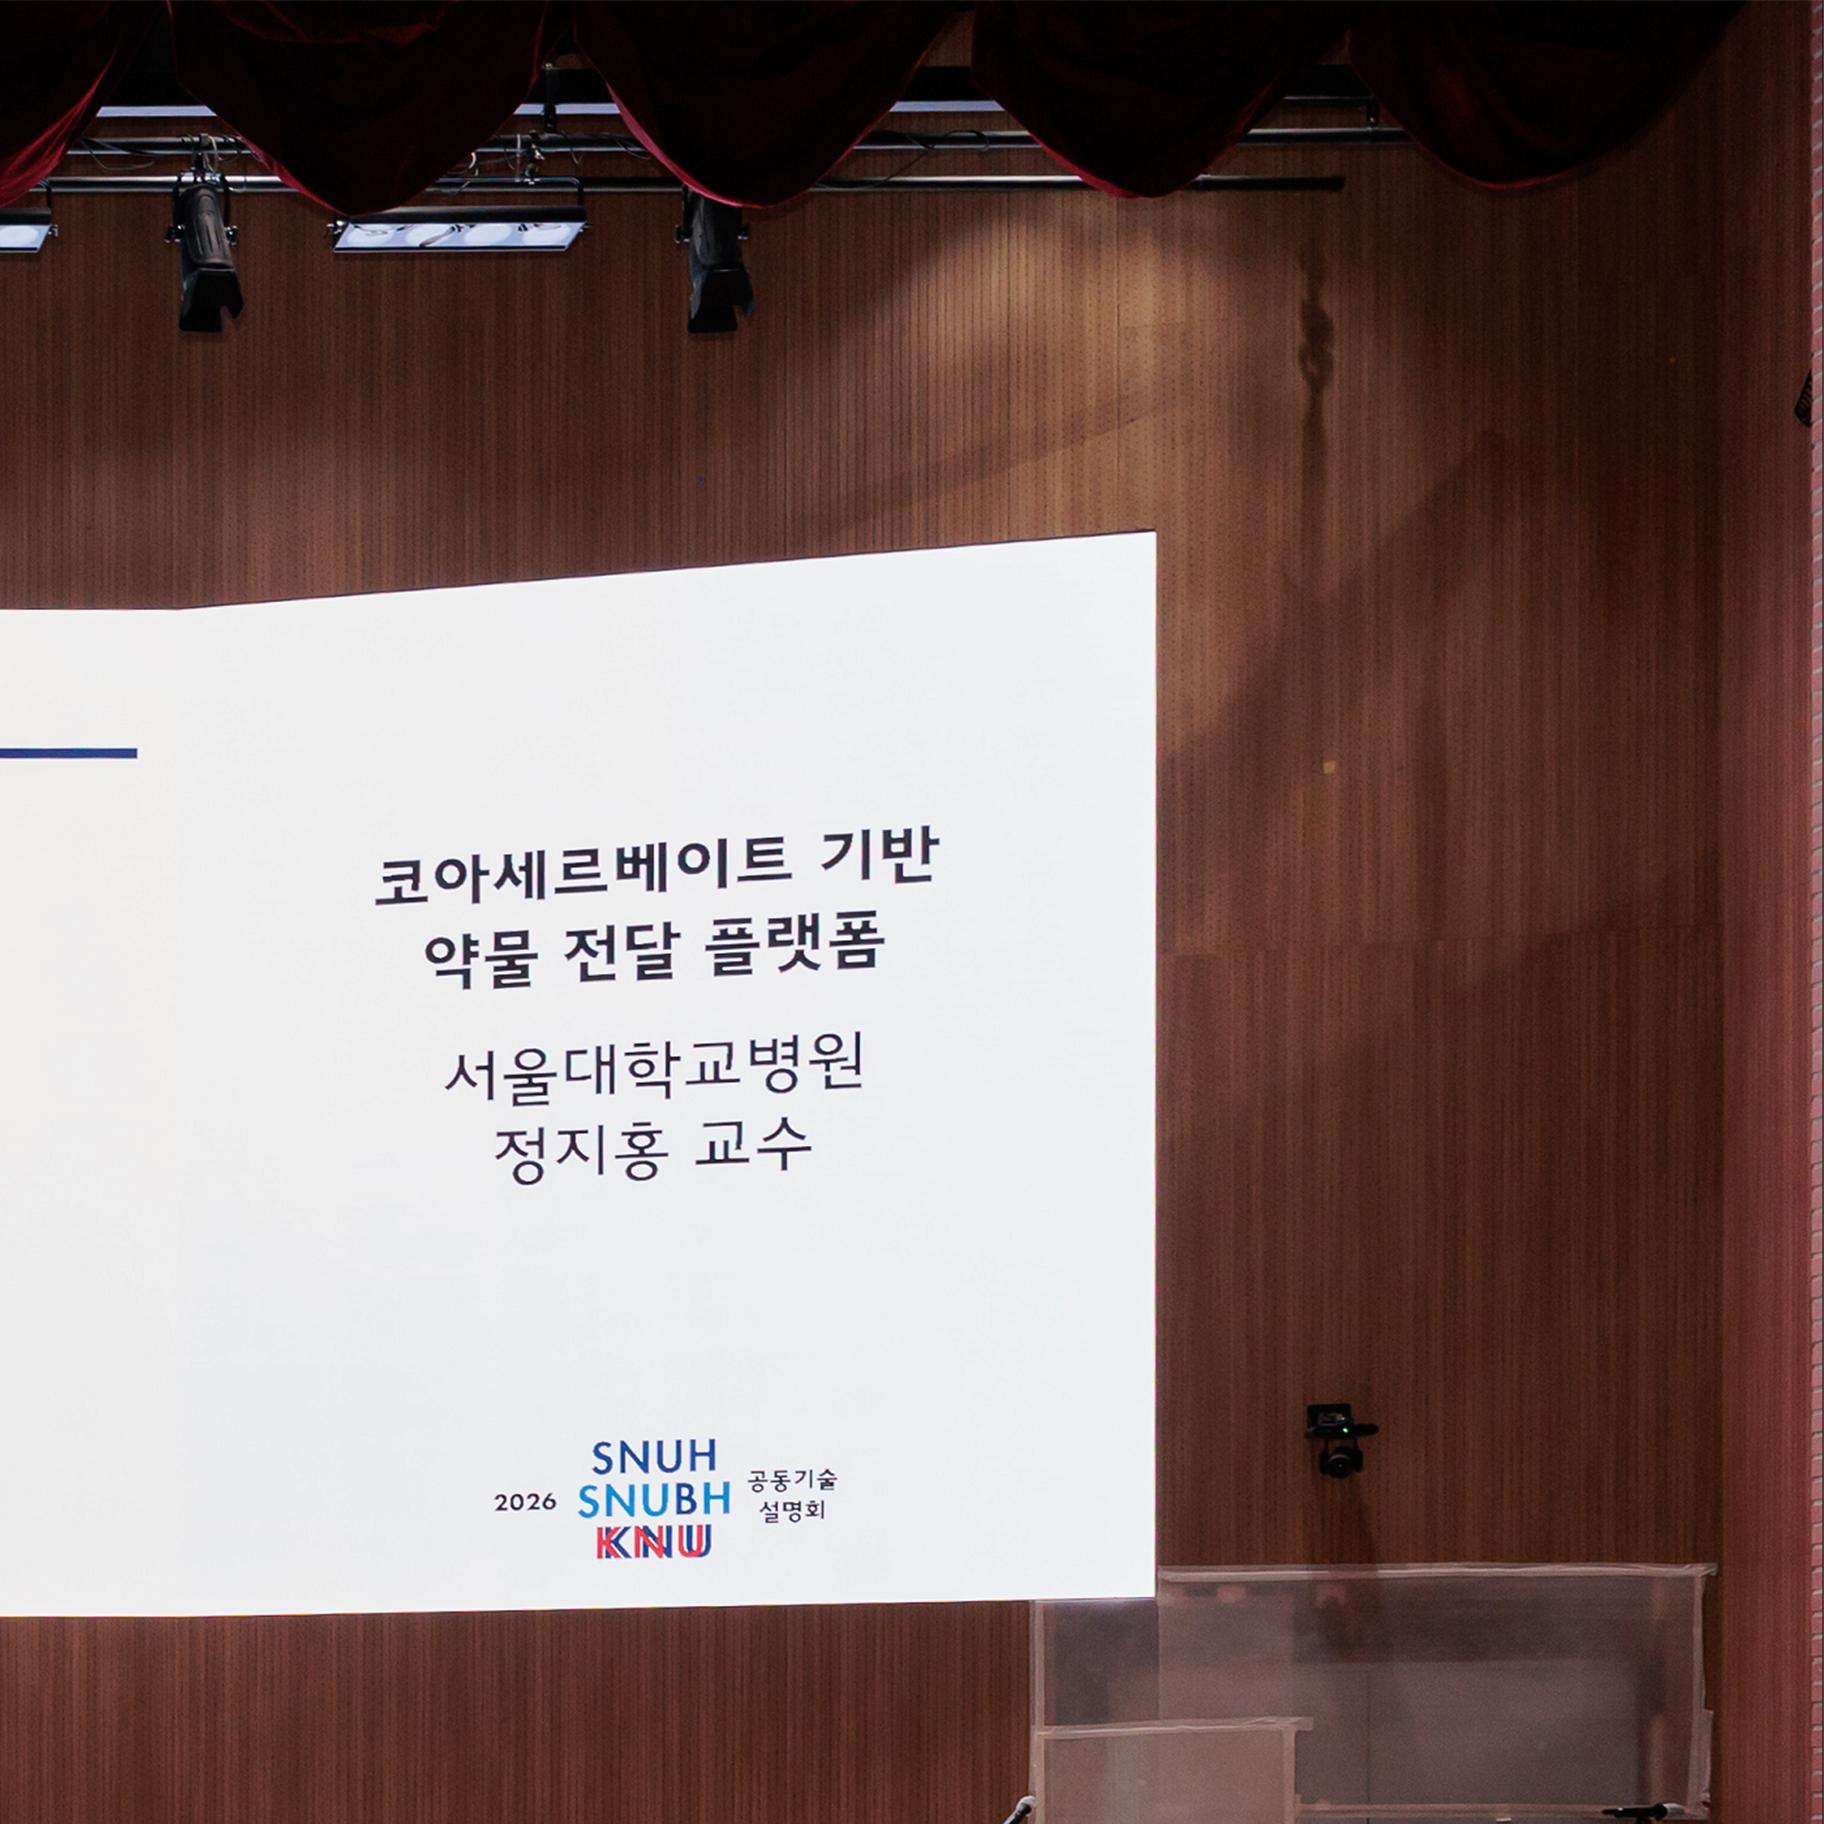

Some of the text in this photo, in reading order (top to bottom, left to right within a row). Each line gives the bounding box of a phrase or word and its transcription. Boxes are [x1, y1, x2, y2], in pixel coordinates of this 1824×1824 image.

[374, 824, 941, 907] 코아세르베이트 기반
[424, 909, 886, 991] 약물 전달 플랫폼
[444, 1030, 863, 1108] 서울대학교병원
[494, 1116, 813, 1186] 정지홍 교수
[591, 1438, 717, 1476] SNUH
[577, 1480, 731, 1520] SNUBH
[746, 1468, 839, 1494] 공동기술
[493, 1492, 558, 1512] 2026
[759, 1499, 825, 1524] 설명회
